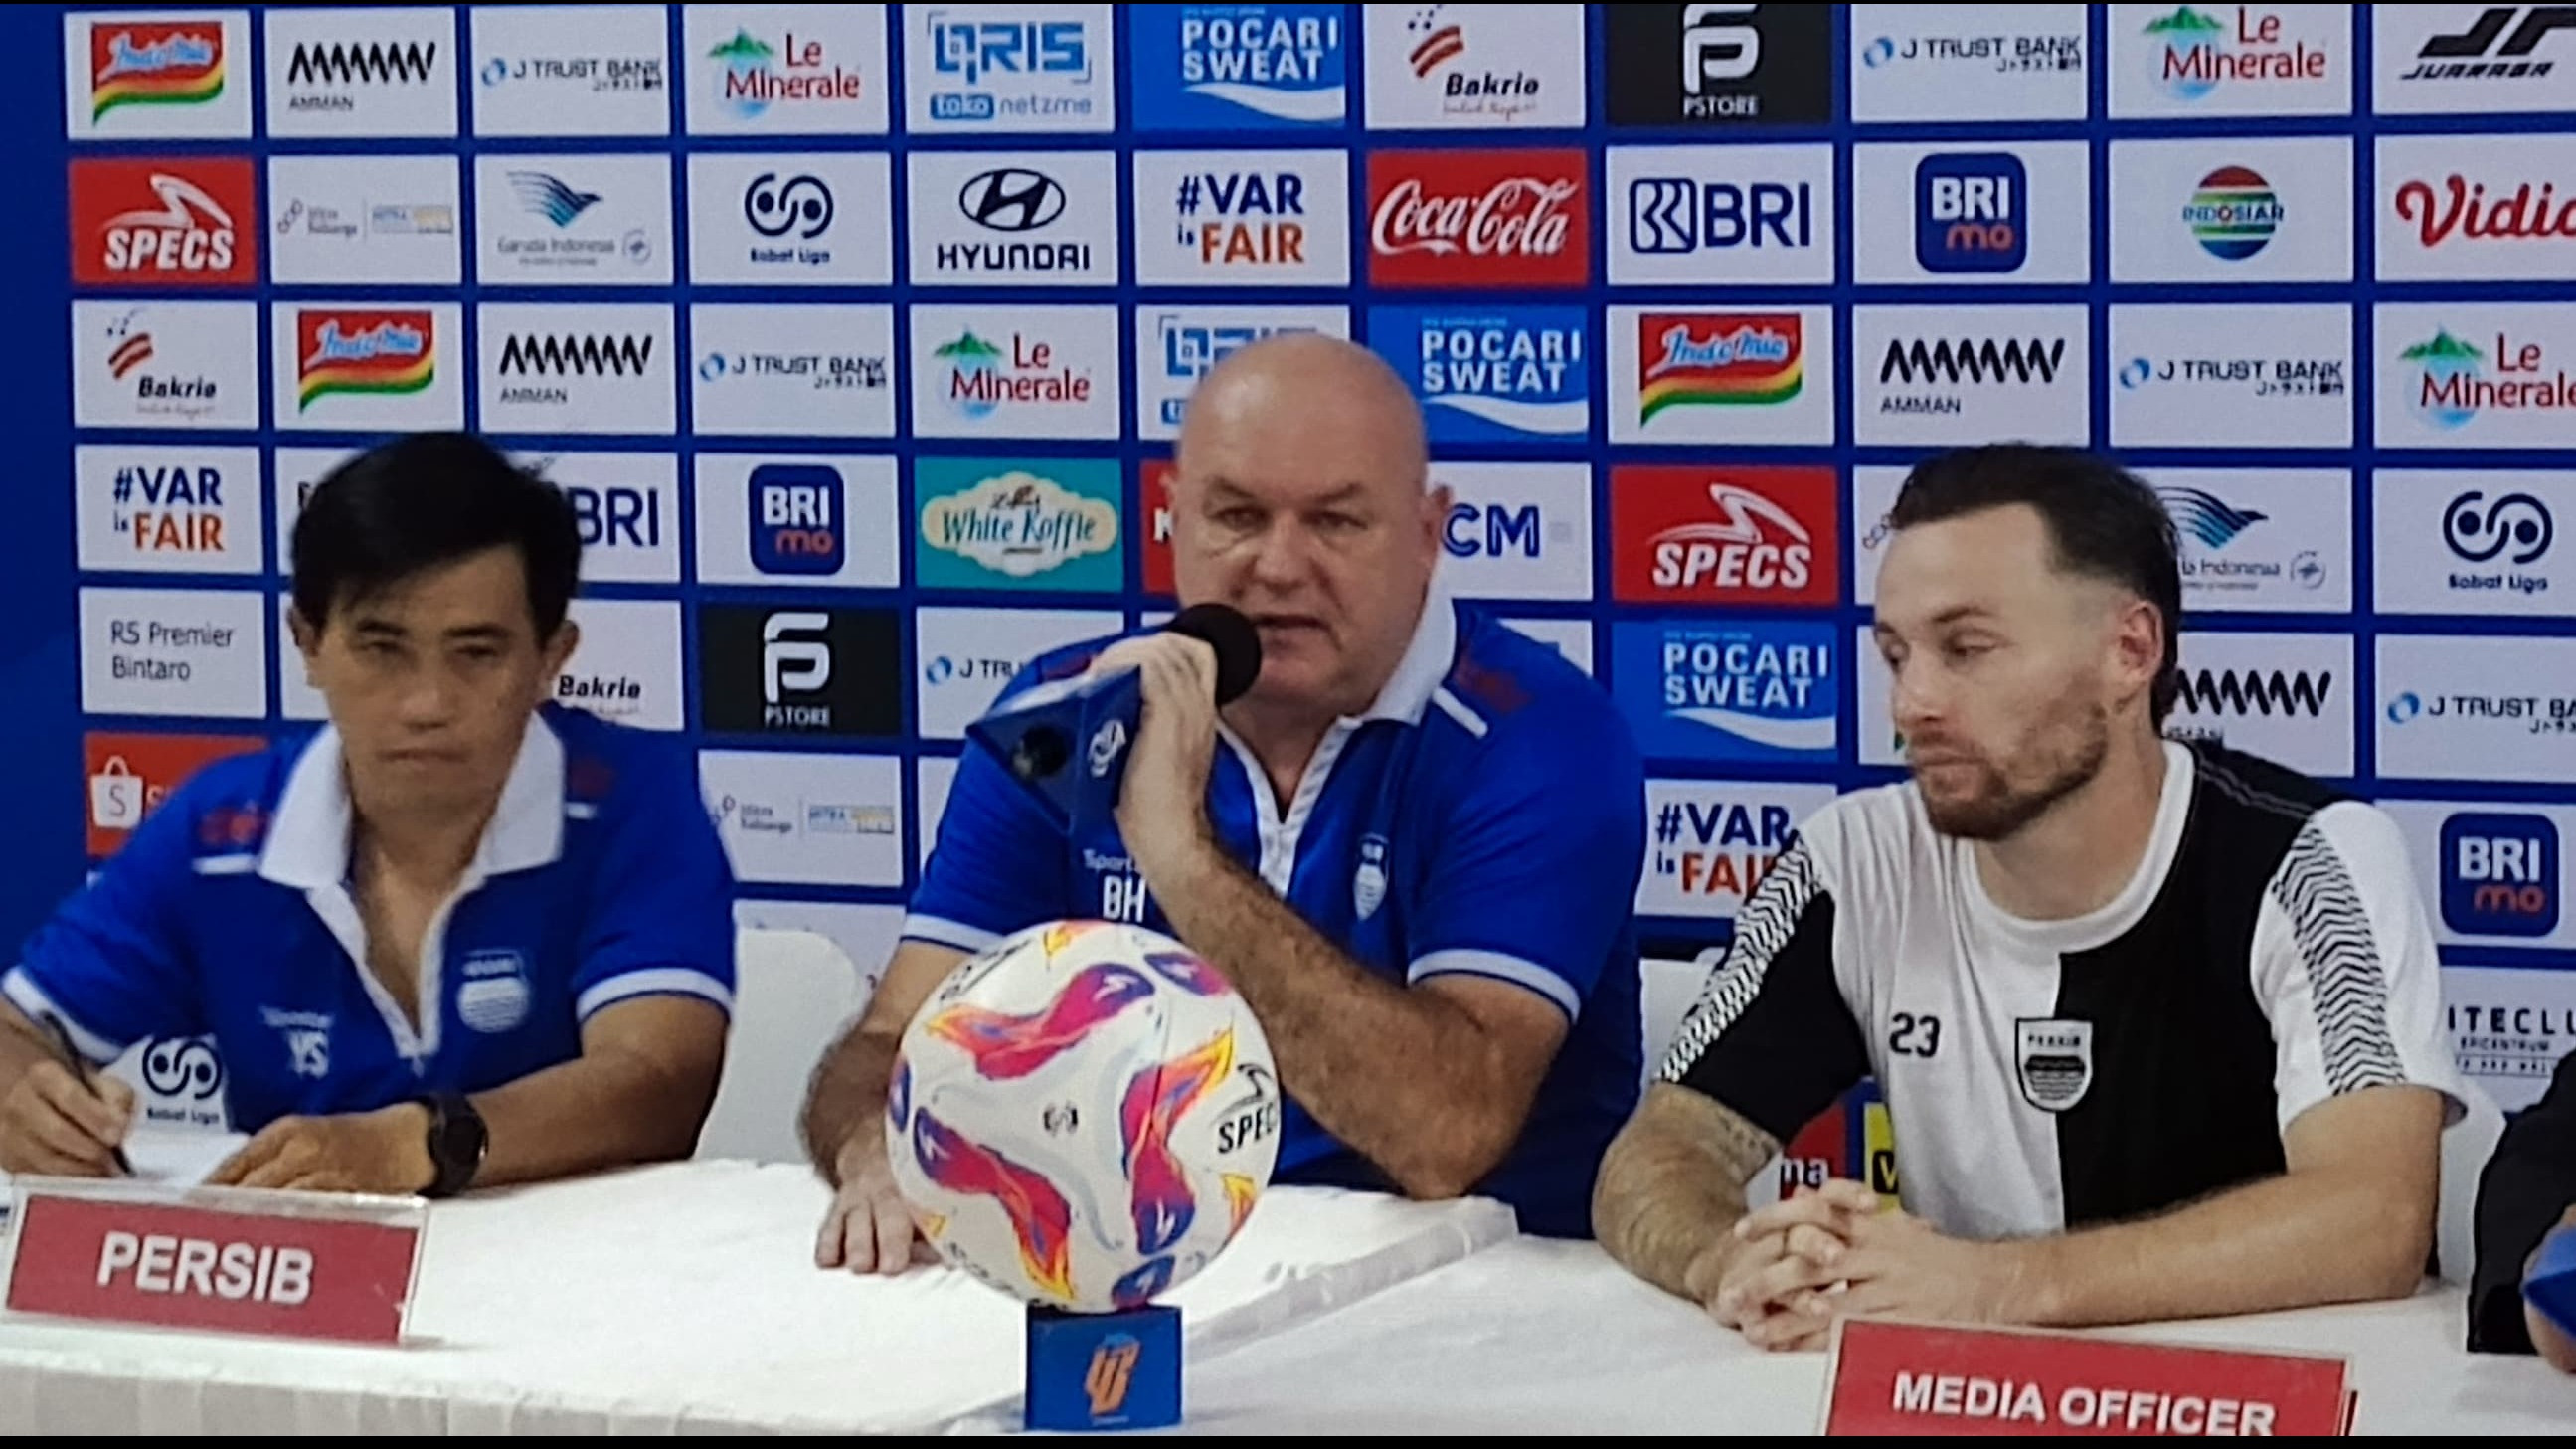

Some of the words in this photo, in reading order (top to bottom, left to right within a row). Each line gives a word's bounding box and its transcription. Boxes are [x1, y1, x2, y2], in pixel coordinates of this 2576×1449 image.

[1181, 18, 1338, 50] POCARI
[2239, 6, 2280, 43] Le
[785, 33, 822, 68] Le
[1182, 49, 1323, 81] SWEAT
[1901, 39, 1917, 60] J
[1928, 37, 2005, 59] TRUST
[2016, 37, 2081, 59] BANK
[2162, 41, 2325, 82] Minerale
[513, 59, 527, 79] J
[532, 58, 599, 78] TRUST
[607, 58, 662, 79] BANK
[725, 67, 860, 99] Minerale
[1446, 72, 1539, 96] Bakrie
[288, 96, 354, 111] AMMAN
[937, 94, 988, 115] toko
[999, 95, 1092, 115] netzme
[1683, 96, 1759, 116] PSTORE
[1177, 174, 1303, 215] #VAR
[1931, 177, 2009, 221] BRI
[1703, 182, 1810, 248] BRI
[2182, 204, 2284, 222] INDOSIAR
[103, 228, 234, 272] SPECS
[1201, 223, 1304, 264] FAIR
[1946, 223, 2013, 250] mo
[937, 243, 1090, 270] HYUNDAI
[1013, 332, 1050, 369] Le
[1422, 329, 1582, 362] POCARI
[2497, 332, 2541, 372] Le
[732, 355, 747, 375] J
[754, 355, 822, 375] TRUST
[829, 355, 886, 376] BANK
[1423, 361, 1567, 394] SWEAT
[2157, 360, 2175, 381] J
[2184, 359, 2265, 381] TRUST
[2276, 360, 2343, 381] BANK
[138, 376, 217, 399] Bakrie
[499, 388, 568, 404] AMMAN
[949, 368, 1091, 402] Minerale
[1880, 396, 1962, 415] AMMAN
[113, 467, 222, 506] #VAR
[568, 487, 660, 547] BRI
[763, 486, 831, 526] BRI
[134, 512, 225, 553] FAIR
[944, 506, 1014, 544] White
[776, 530, 833, 555] mo
[1652, 543, 1812, 589] SPECS
[2508, 574, 2547, 593] Liga
[111, 621, 139, 645] RS
[149, 622, 236, 647] Premier
[112, 656, 191, 682] Bintaro
[959, 658, 973, 678] J
[1664, 642, 1827, 677] POCARI
[559, 675, 641, 699] Bakrie
[1665, 675, 1812, 708] SWEAT
[765, 705, 830, 727] PSTORE
[2428, 696, 2445, 716] J
[2452, 696, 2540, 717] TRUST
[1656, 802, 1791, 846] #VAR
[2458, 836, 2541, 882] BRI
[1103, 875, 1146, 923] BH
[2475, 886, 2545, 913] mo
[1889, 1012, 1941, 1059] 23
[97, 1230, 314, 1306] PERSIB
[1893, 1370, 2047, 1423] MEDIA
[2059, 1386, 2277, 1437] OFFICER
